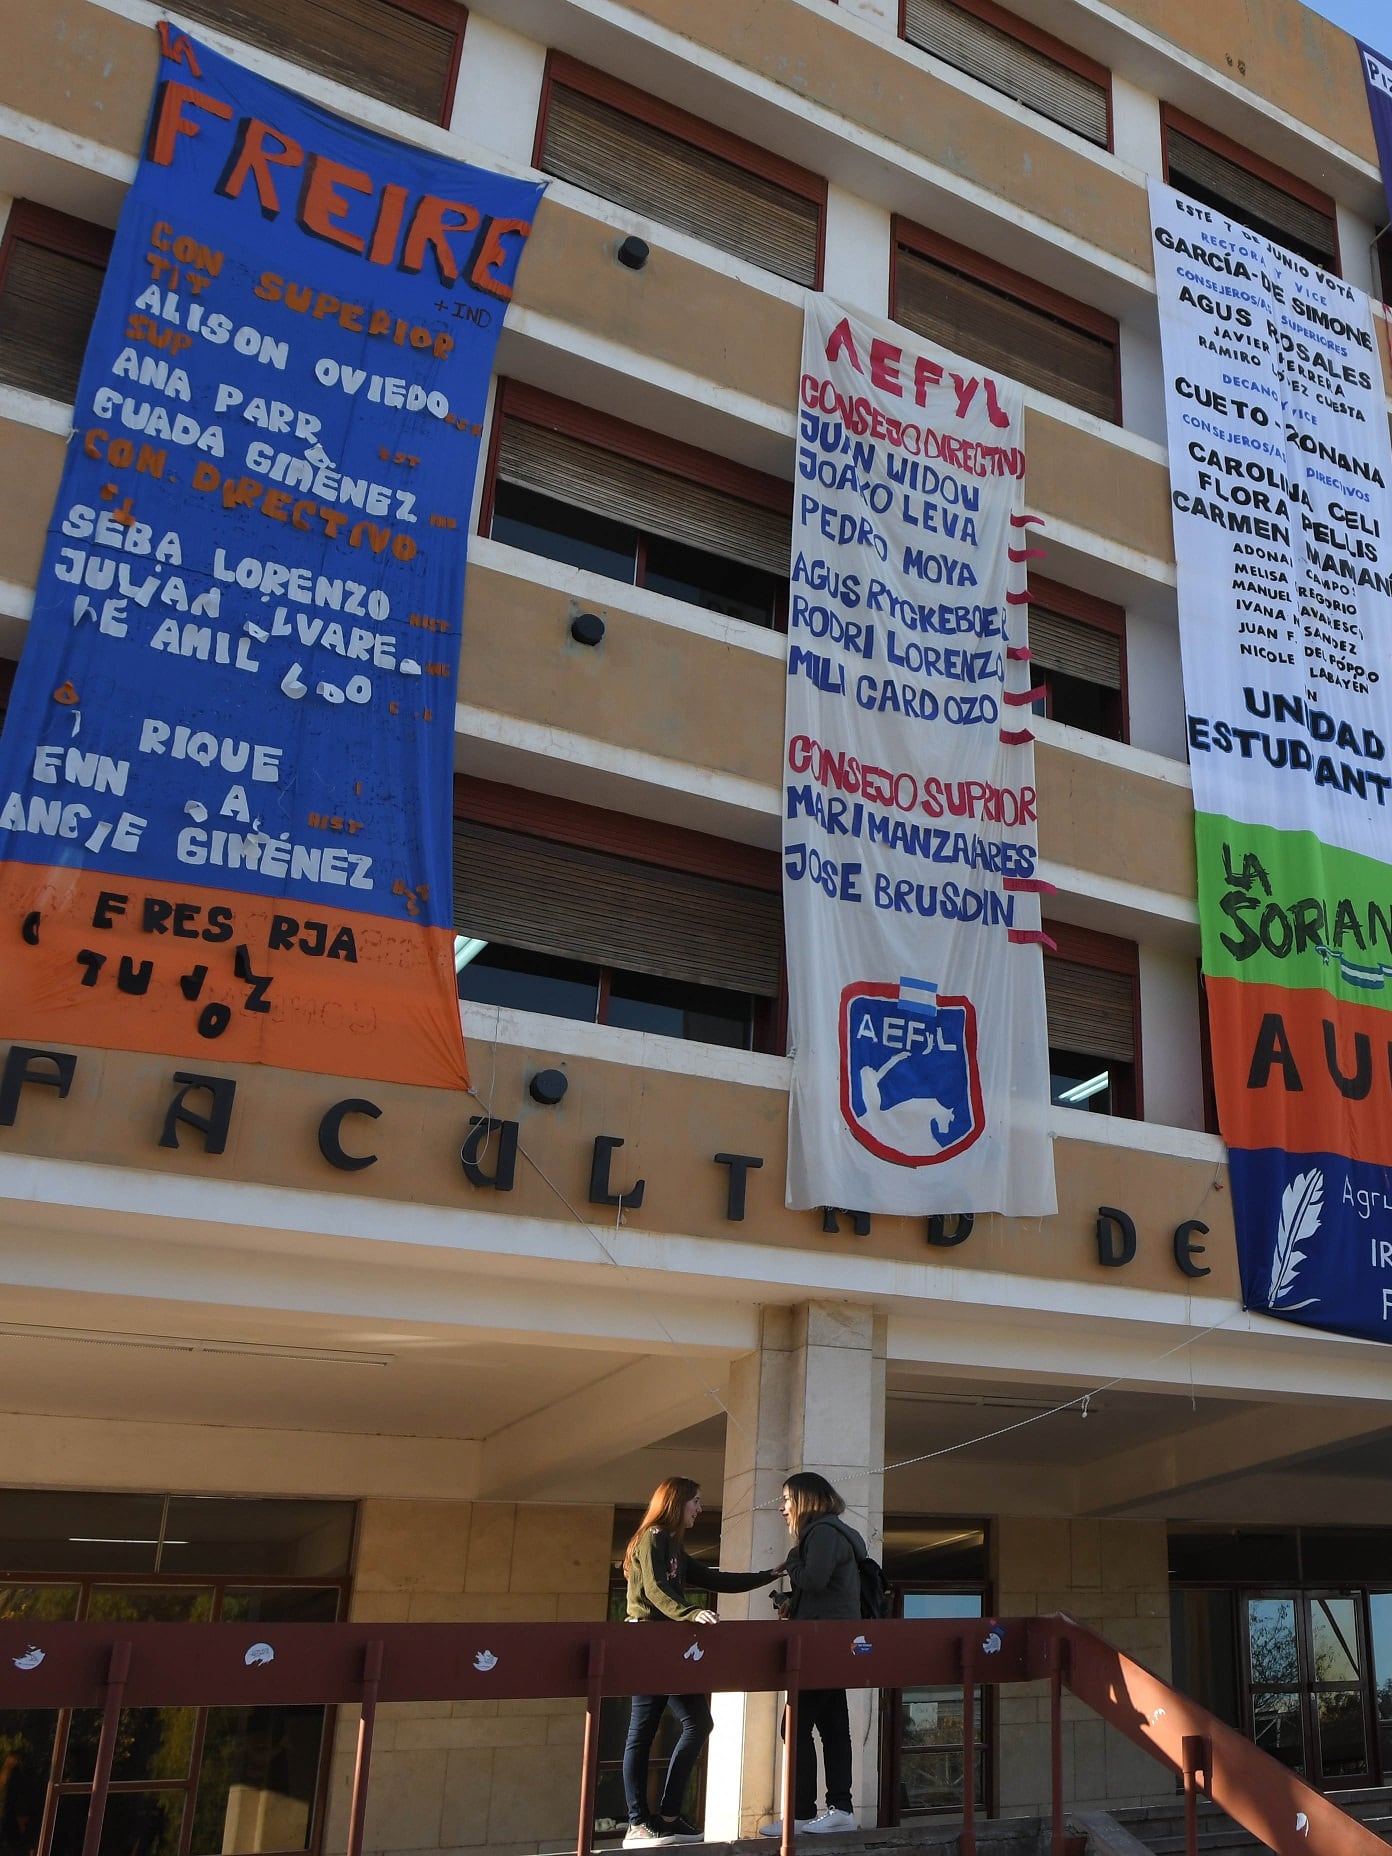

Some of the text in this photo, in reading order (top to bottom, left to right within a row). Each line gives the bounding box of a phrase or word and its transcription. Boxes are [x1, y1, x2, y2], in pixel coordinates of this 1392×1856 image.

[146, 80, 531, 302] FREIRE
[146, 252, 211, 295] TIT
[1175, 199, 1213, 224] ESTE
[1242, 231, 1260, 244] DE
[1266, 243, 1309, 278] JUNIO
[1316, 271, 1355, 302] VOTÁ
[151, 221, 455, 361] CON SUPERIOR
[1295, 282, 1327, 306] VICE
[125, 314, 192, 357] SUP
[135, 283, 449, 419] ALISON OVIEDO
[1179, 285, 1372, 390] AGUS ROSALES
[1213, 326, 1270, 353] JAVIER
[1281, 315, 1348, 357] SUPERIORES
[1292, 297, 1373, 352] SIMONE
[112, 347, 192, 402] ANA
[1175, 376, 1269, 427] CUETO
[1199, 335, 1261, 367] RAMIRO
[1316, 393, 1366, 422] CUESTA
[1222, 373, 1279, 401] DECANO
[93, 386, 225, 458] GUADA
[801, 373, 921, 455] CONSEJO
[801, 409, 980, 512] JUAN WIDOW
[1188, 441, 1381, 538] CAROLINA CELI
[192, 461, 417, 562] DIRECTIVO
[902, 493, 979, 547] LEVA
[1172, 490, 1290, 547] CARMEN
[1198, 470, 1290, 522] FLORA
[62, 504, 182, 566] SEBA
[213, 548, 390, 621] LORENZO
[801, 493, 979, 587] PEDRO MOYA
[791, 551, 1010, 641] AGUS RYCKEBOER
[1232, 579, 1291, 602] MANUEL
[1234, 562, 1288, 583] MELISA
[792, 595, 1005, 684] RODRI LORENZO
[1236, 598, 1286, 621] IVANA
[1238, 622, 1278, 640] JUAN
[1240, 643, 1295, 665] NICOLE
[788, 645, 998, 726] MILI CARDOZO
[1243, 686, 1386, 761] UNIDAD
[788, 734, 918, 812] CONSEJO
[787, 784, 864, 838] MARI
[784, 842, 862, 903] JOSE
[1222, 842, 1273, 896] LA
[1096, 1206, 1212, 1279] DE
